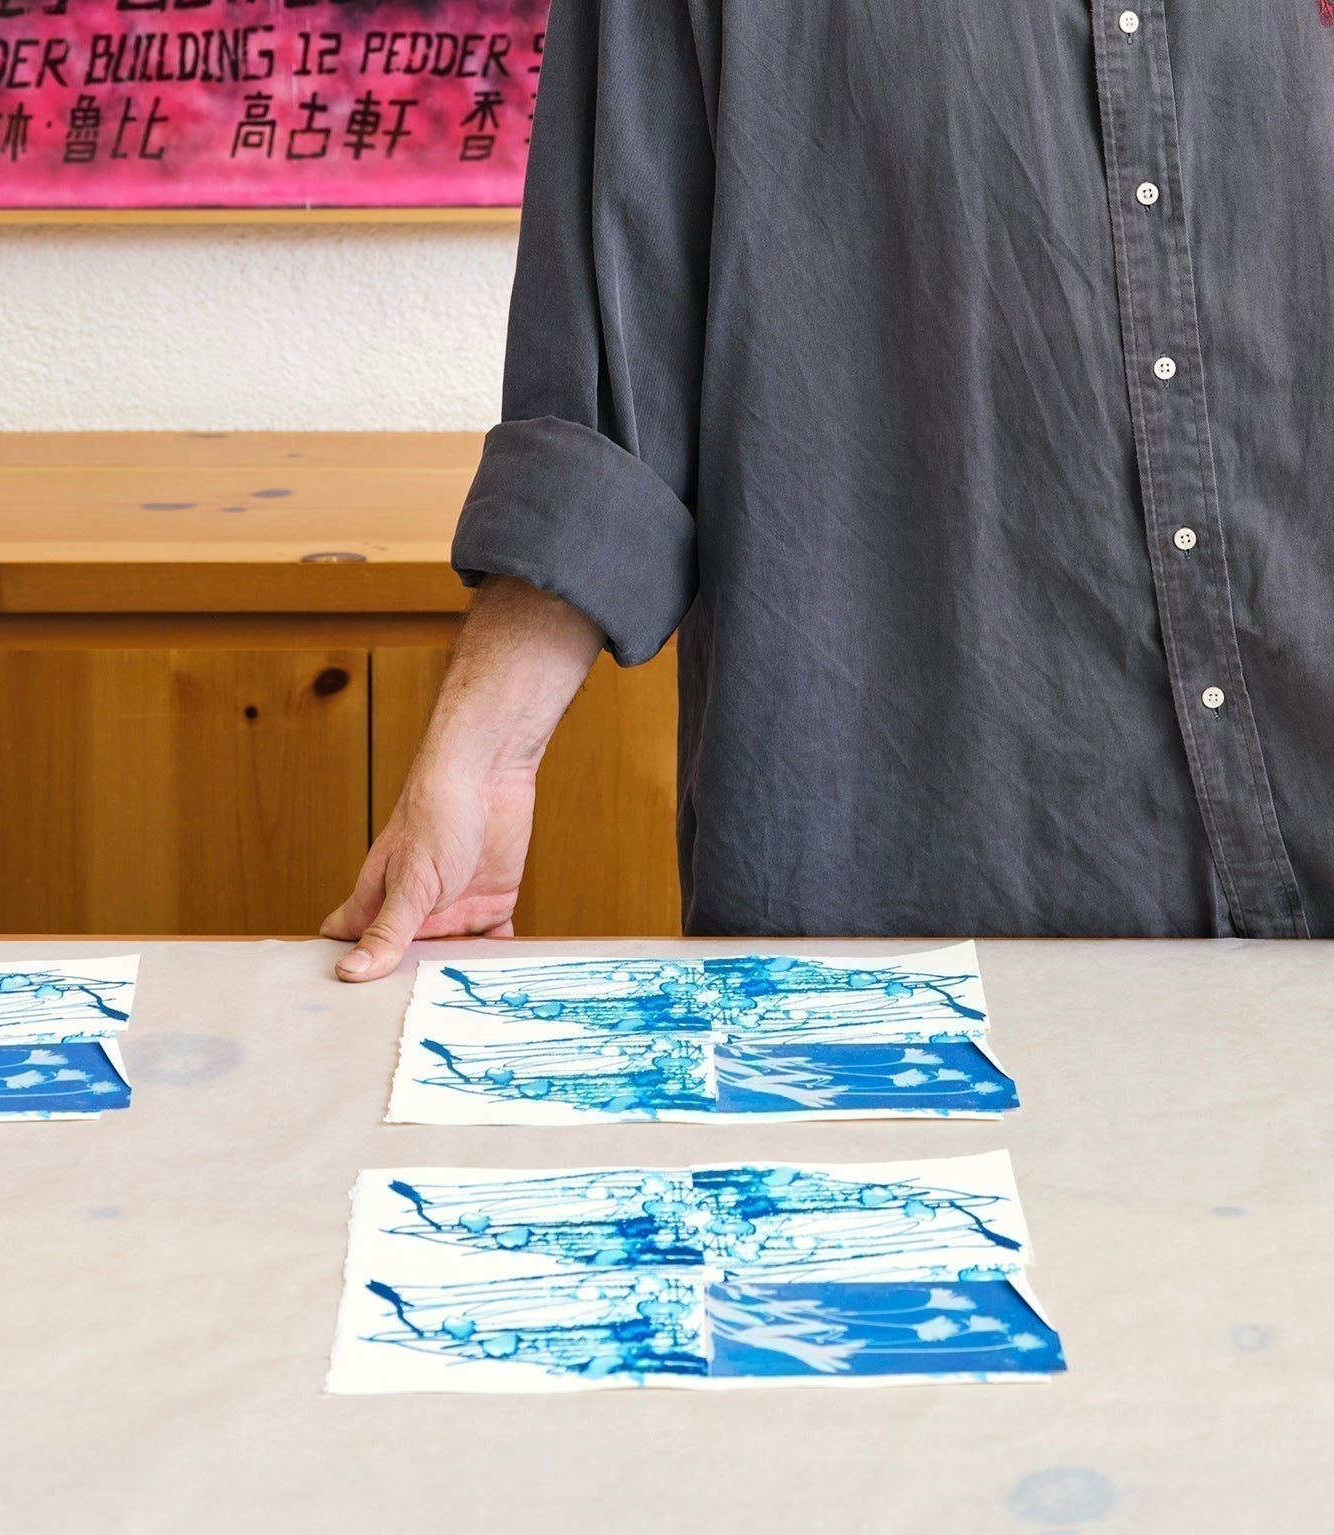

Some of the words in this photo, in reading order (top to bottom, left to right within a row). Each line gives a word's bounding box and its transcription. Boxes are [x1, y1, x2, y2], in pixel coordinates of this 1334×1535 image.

[84, 24, 275, 87] BUILDING
[293, 31, 342, 77] 12
[359, 30, 511, 78] PEDDER
[230, 89, 419, 161] 高古軒
